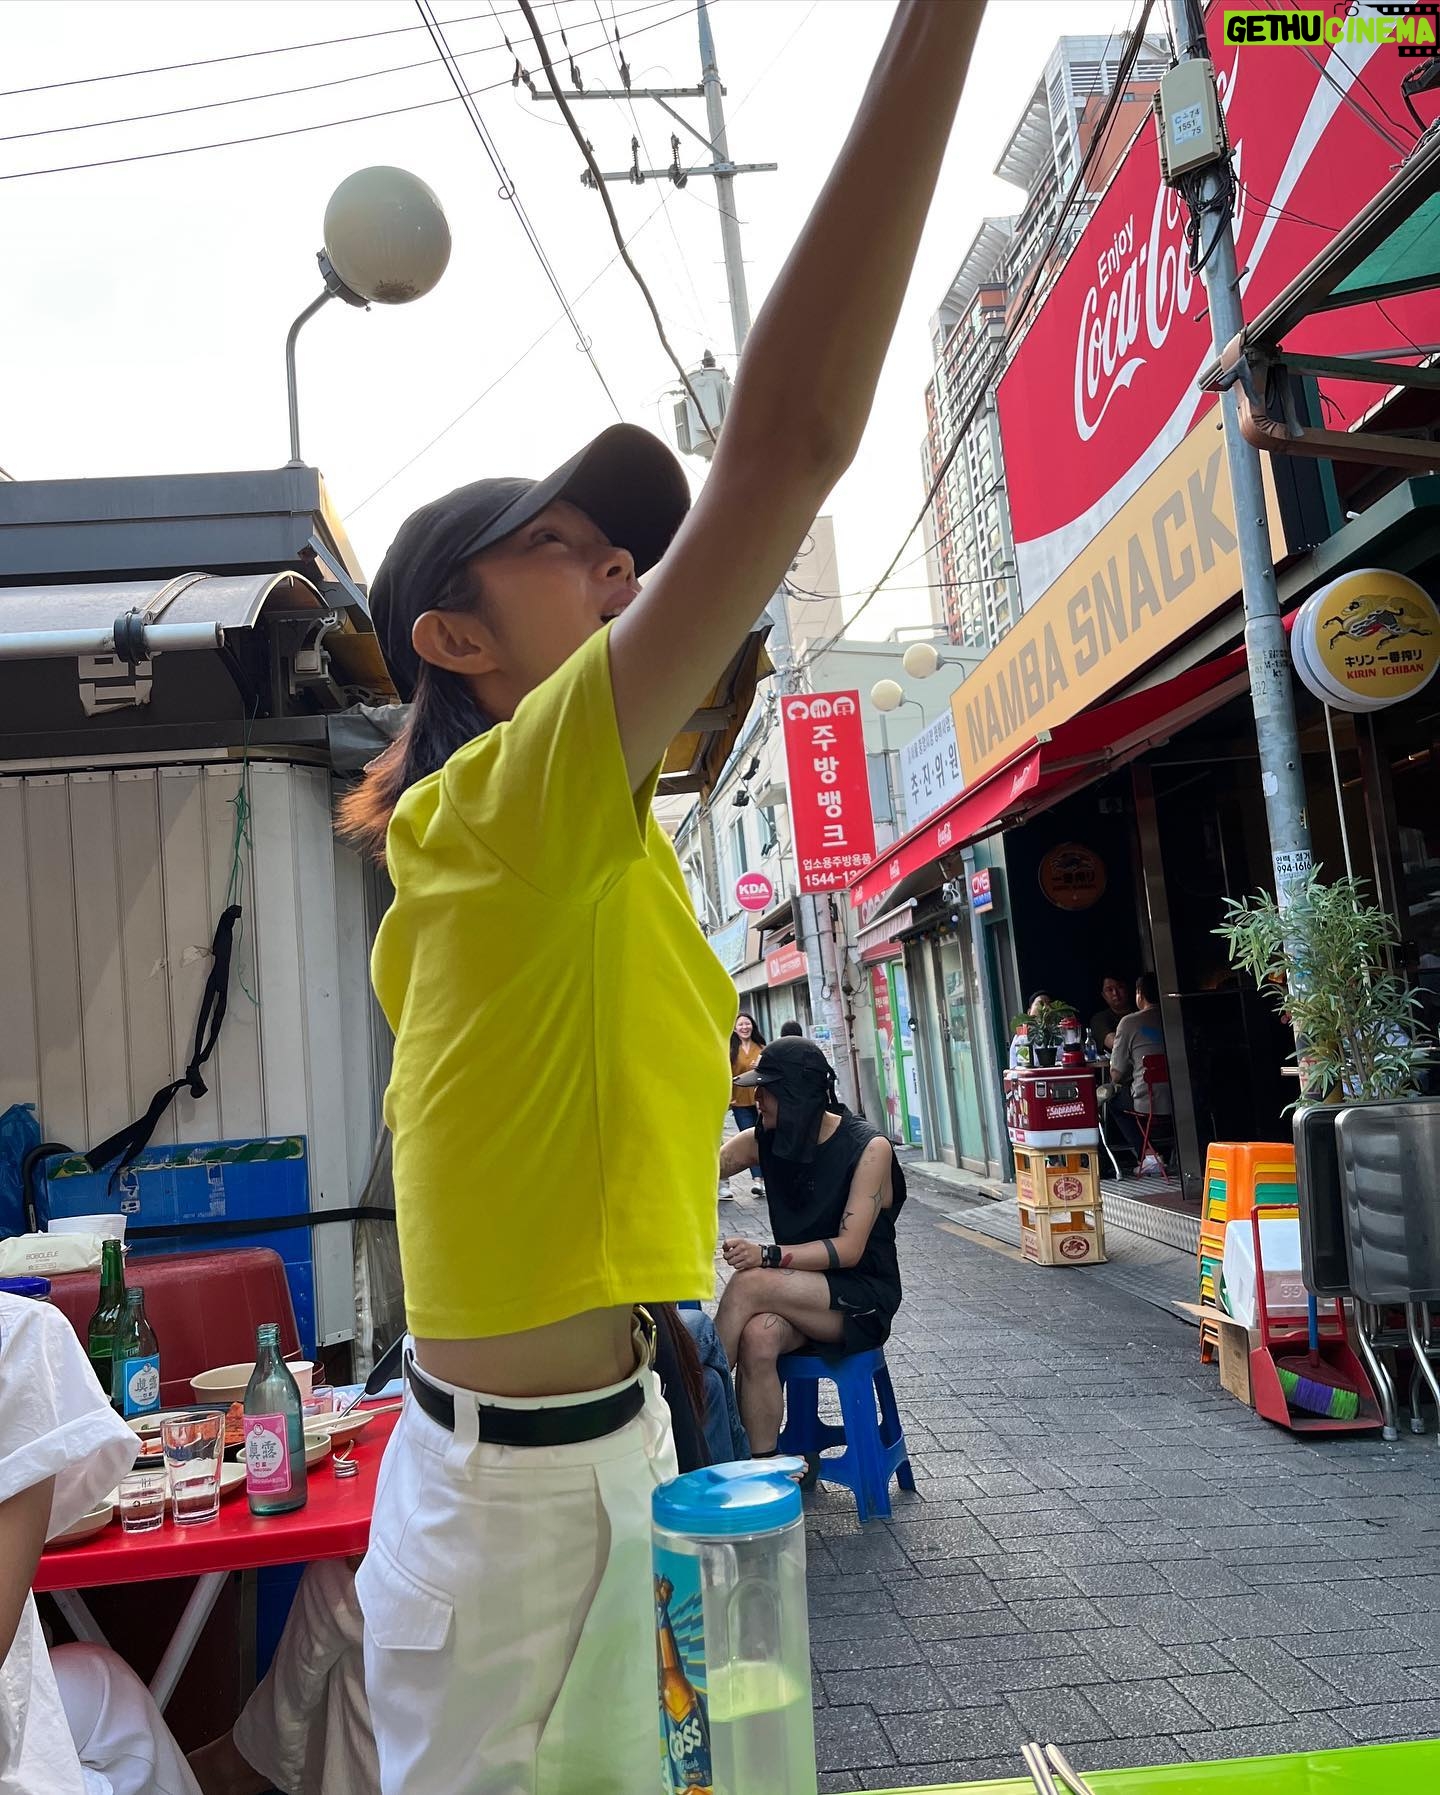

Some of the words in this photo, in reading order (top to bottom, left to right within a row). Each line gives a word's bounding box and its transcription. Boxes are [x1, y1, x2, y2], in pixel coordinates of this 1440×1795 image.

[1097, 214, 1134, 289] Enjoy
[965, 621, 1069, 764] NAMBA
[1066, 444, 1238, 677] SNACK
[1346, 668, 1377, 680] KIRIN
[1382, 663, 1424, 676] ICHIBAN
[802, 853, 872, 871] 업소용주방용품
[738, 883, 769, 896] KDA
